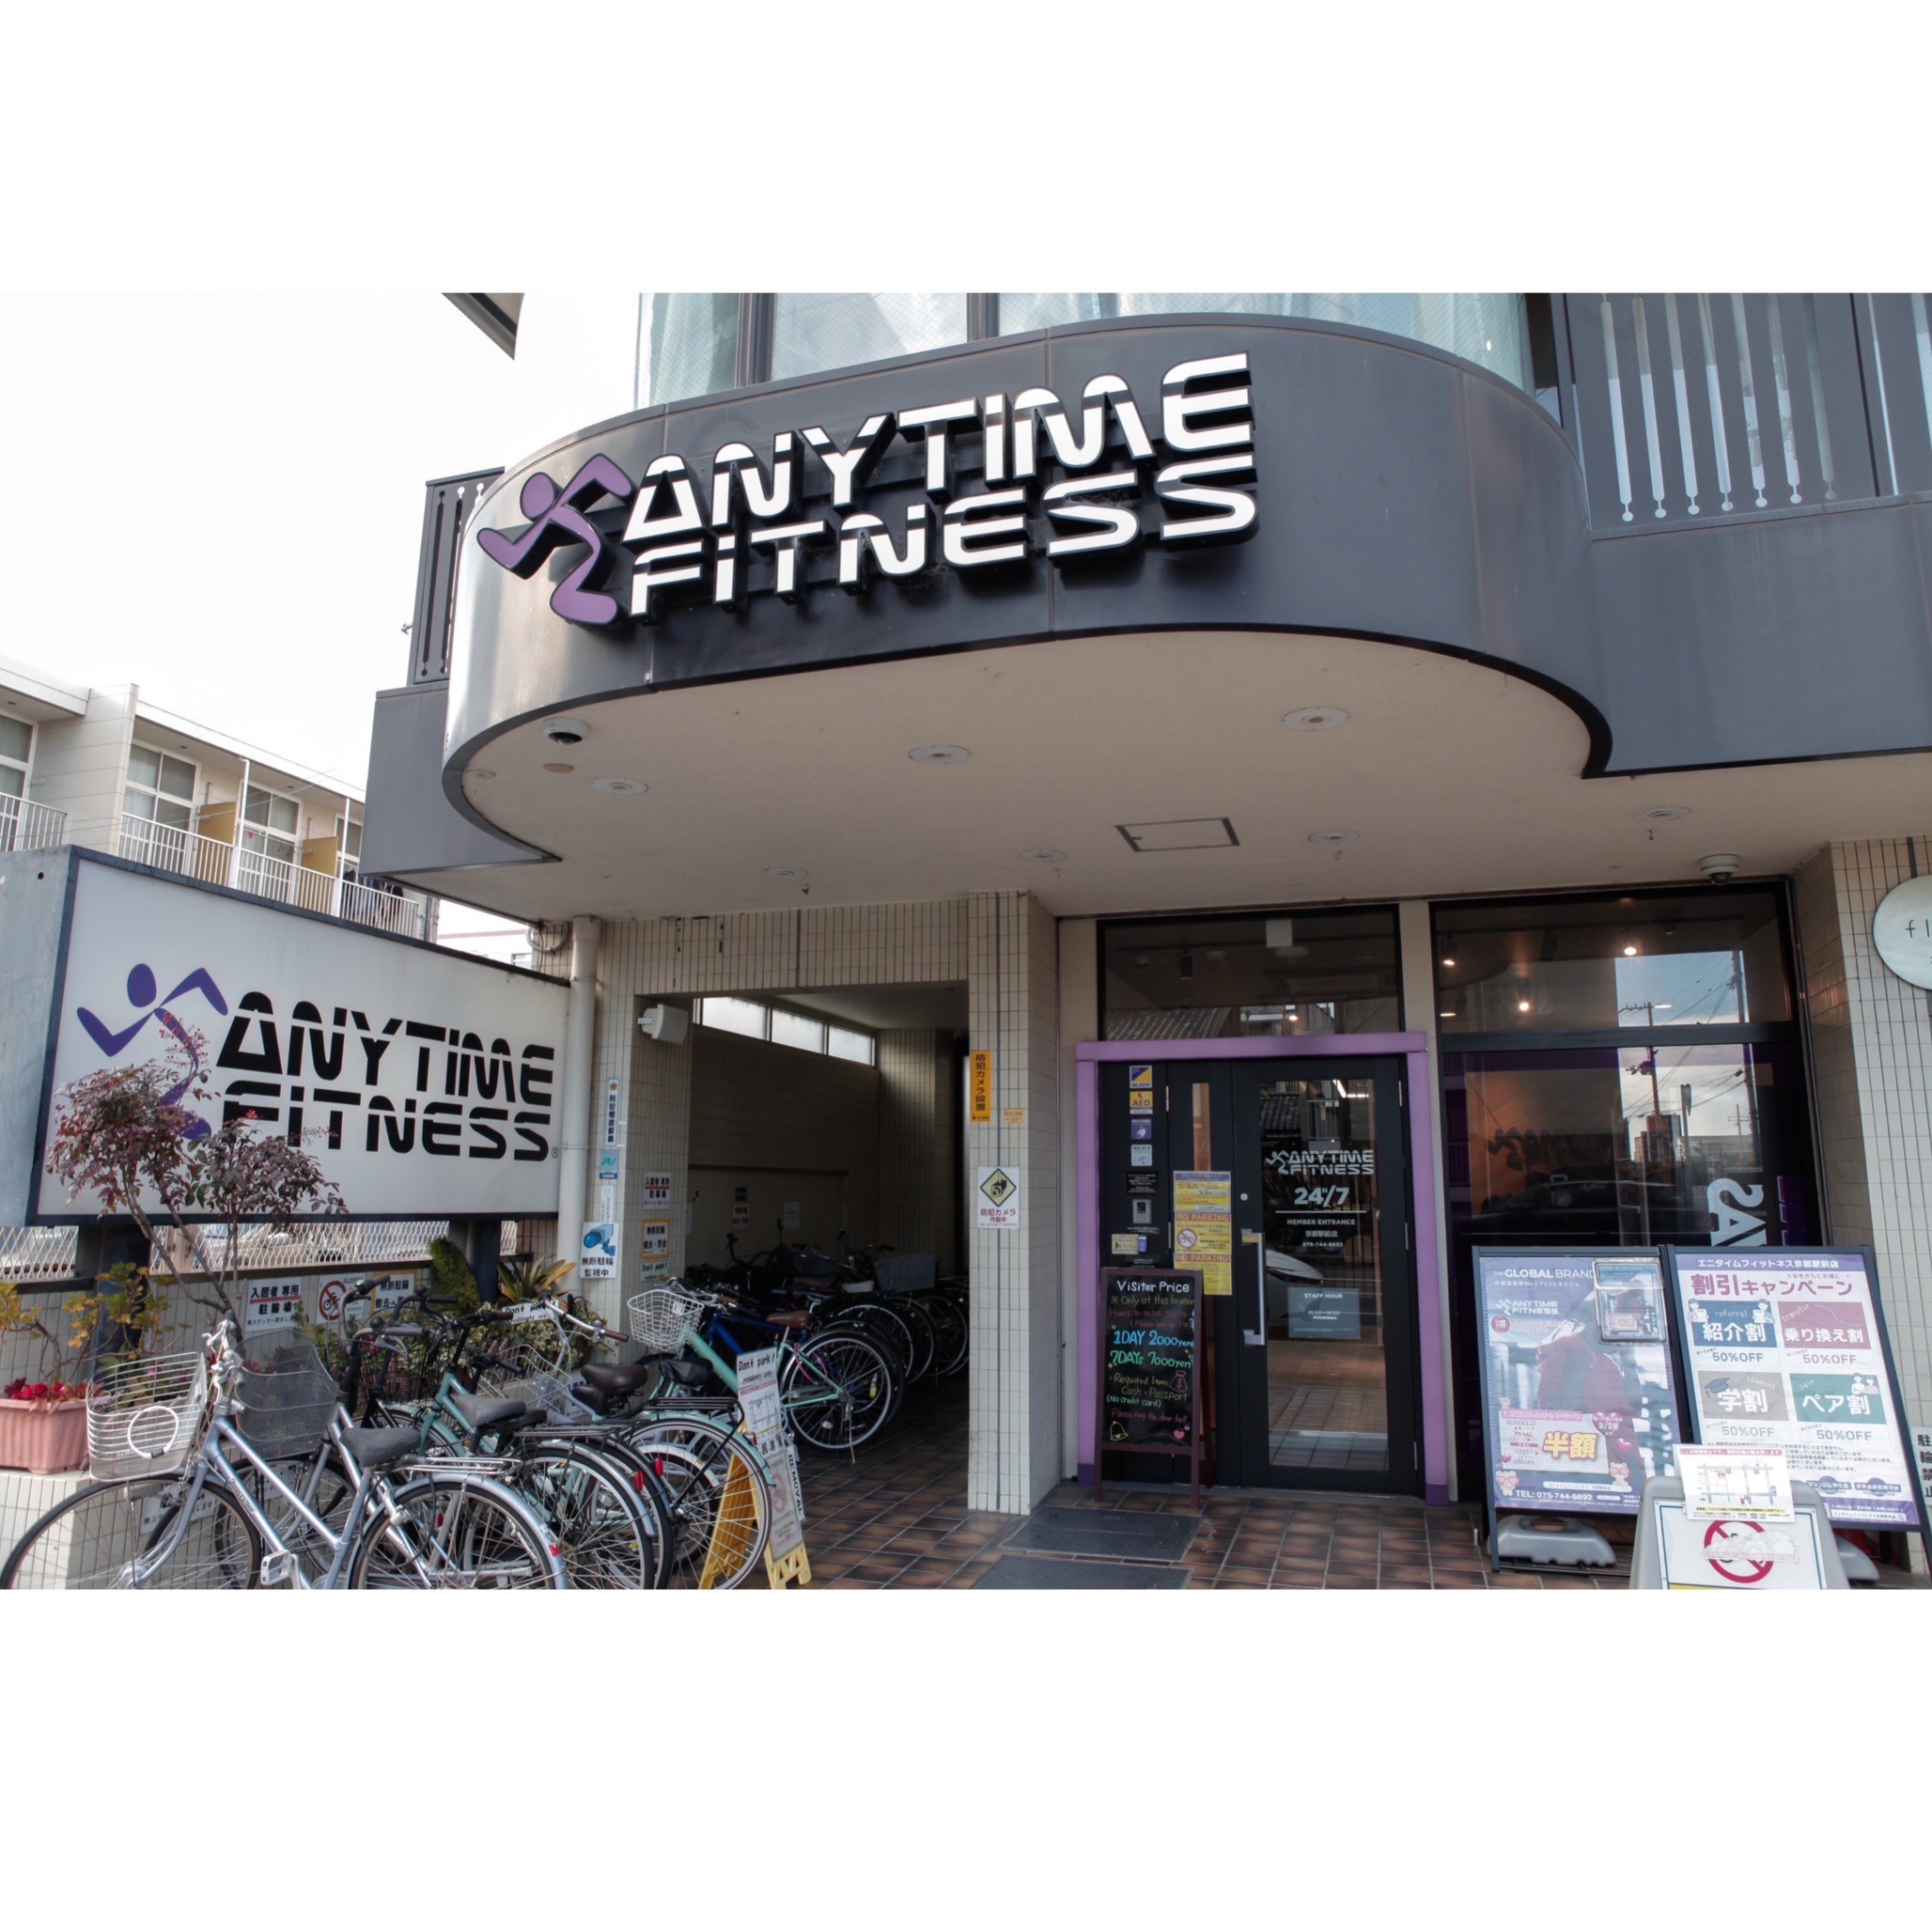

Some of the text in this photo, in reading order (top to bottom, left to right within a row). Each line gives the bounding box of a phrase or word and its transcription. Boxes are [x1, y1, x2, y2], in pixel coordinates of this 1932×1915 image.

[621, 352, 1253, 546] ANYTIME
[630, 455, 1258, 617] FITNESS
[216, 991, 554, 1106] ANYTIME
[975, 1054, 986, 1111] 防犯カメラ設置
[223, 1080, 552, 1161] FITNESS
[1288, 1149, 1374, 1163] ANYTIME
[1290, 1164, 1374, 1175] FITNESS
[980, 1208, 1017, 1217] 防犯カメラ
[582, 1256, 614, 1267] 無断駐輪
[1698, 1259, 1839, 1269] エニタイムフィットネス京都駅前店
[584, 1269, 609, 1278] 監視中
[1504, 1269, 1554, 1278] GLOBAL
[250, 1284, 299, 1299] 入居者 専用
[1159, 1281, 1190, 1293] Price
[1690, 1274, 1853, 1297] 割引キャンペーン
[258, 1301, 292, 1315] 駐輪場
[1121, 1296, 1139, 1306] Only
[1141, 1297, 1151, 1305] at
[1154, 1295, 1168, 1305] this
[1114, 1330, 1193, 1347] 1DAY 2000yen
[1703, 1322, 1767, 1343] 紹介割
[1784, 1328, 1863, 1343] 乗り換え割
[1148, 1351, 1192, 1369] 7000yen
[1712, 1352, 1764, 1362] 50%OFF
[1803, 1354, 1857, 1364] 50%OFF
[1746, 1375, 1777, 1391] student
[1121, 1386, 1188, 1402] Cash Passport
[1717, 1389, 1768, 1413] 学割
[1802, 1394, 1871, 1415] ペア割
[1722, 1425, 1774, 1438] 50%OFF
[1816, 1429, 1872, 1441] 50%OFF
[1542, 1430, 1599, 1461] 半額
[788, 1454, 804, 1515] REMOVAL
[1536, 1492, 1593, 1502] 075-744-6692
